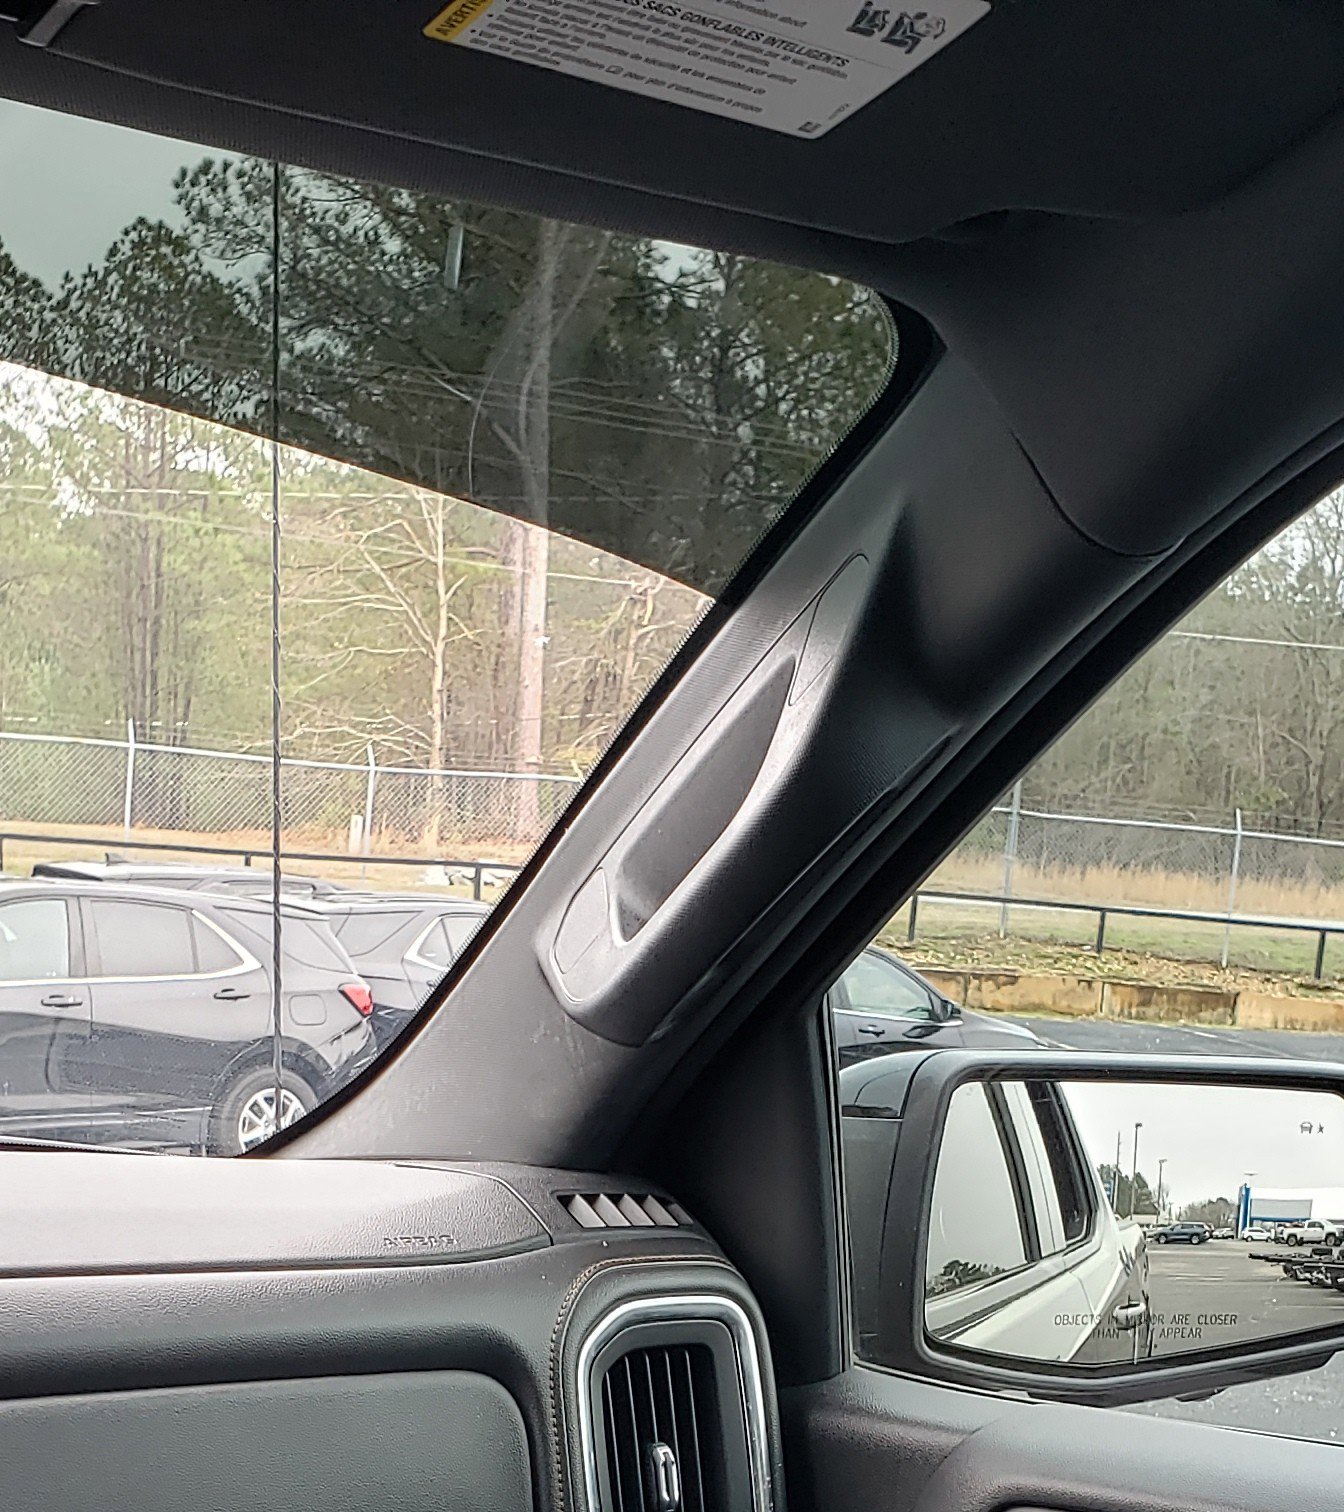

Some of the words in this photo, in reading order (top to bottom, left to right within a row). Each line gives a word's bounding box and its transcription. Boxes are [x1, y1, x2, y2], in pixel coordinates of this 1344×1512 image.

[679, 11, 765, 41] GONFLABLES
[762, 36, 849, 67] INTELLIGENTS
[1170, 1314, 1190, 1325] ARE
[1196, 1314, 1238, 1325] CLOSER
[1092, 1327, 1120, 1339] THAN
[1158, 1327, 1203, 1339] APPEAR
